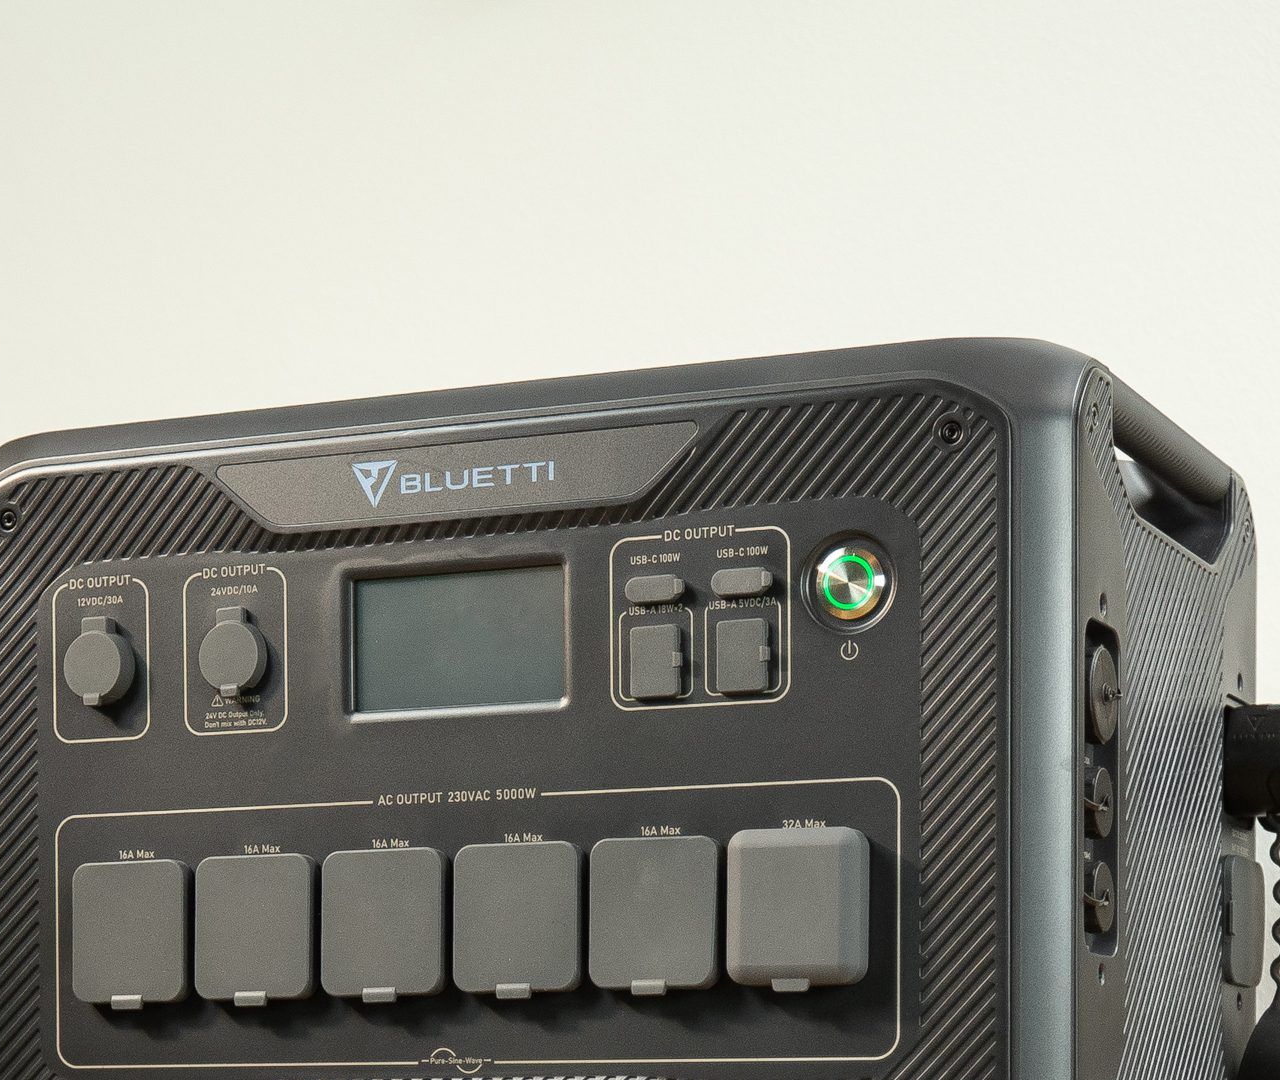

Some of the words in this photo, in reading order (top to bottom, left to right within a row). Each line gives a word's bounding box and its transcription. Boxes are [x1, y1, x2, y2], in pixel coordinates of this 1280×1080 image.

[400, 460, 556, 494] BLUETTI
[664, 530, 681, 541] DC
[684, 524, 735, 540] OUTPUT
[716, 547, 744, 558] USB-C
[746, 545, 768, 555] 100W
[630, 555, 657, 565] USB-C
[659, 553, 680, 563] 100W
[203, 567, 218, 579] DC
[220, 563, 266, 577] OUTPUT
[69, 578, 84, 590] DC
[86, 574, 131, 588] OUTPUT
[210, 585, 259, 597] 24VDC/10A
[77, 596, 123, 607] 12VDC/30A
[709, 599, 736, 610] USB-A
[738, 596, 777, 608] 5VDC/3A
[628, 605, 657, 616] USB-A
[377, 794, 394, 806] AC
[396, 791, 443, 805] OUTPUT
[447, 790, 491, 803] 230VAC
[496, 788, 537, 800] 5000W
[782, 820, 802, 829] 32A
[805, 819, 826, 829] Max
[640, 826, 657, 836] 16A
[660, 825, 681, 835] Max
[372, 839, 388, 848] 16A
[390, 838, 410, 848] Max
[504, 833, 520, 843] 16A
[523, 832, 543, 842] Max
[119, 850, 134, 860] 16A
[136, 849, 155, 859] Max
[244, 845, 259, 855] 16A
[261, 844, 281, 854] Max
